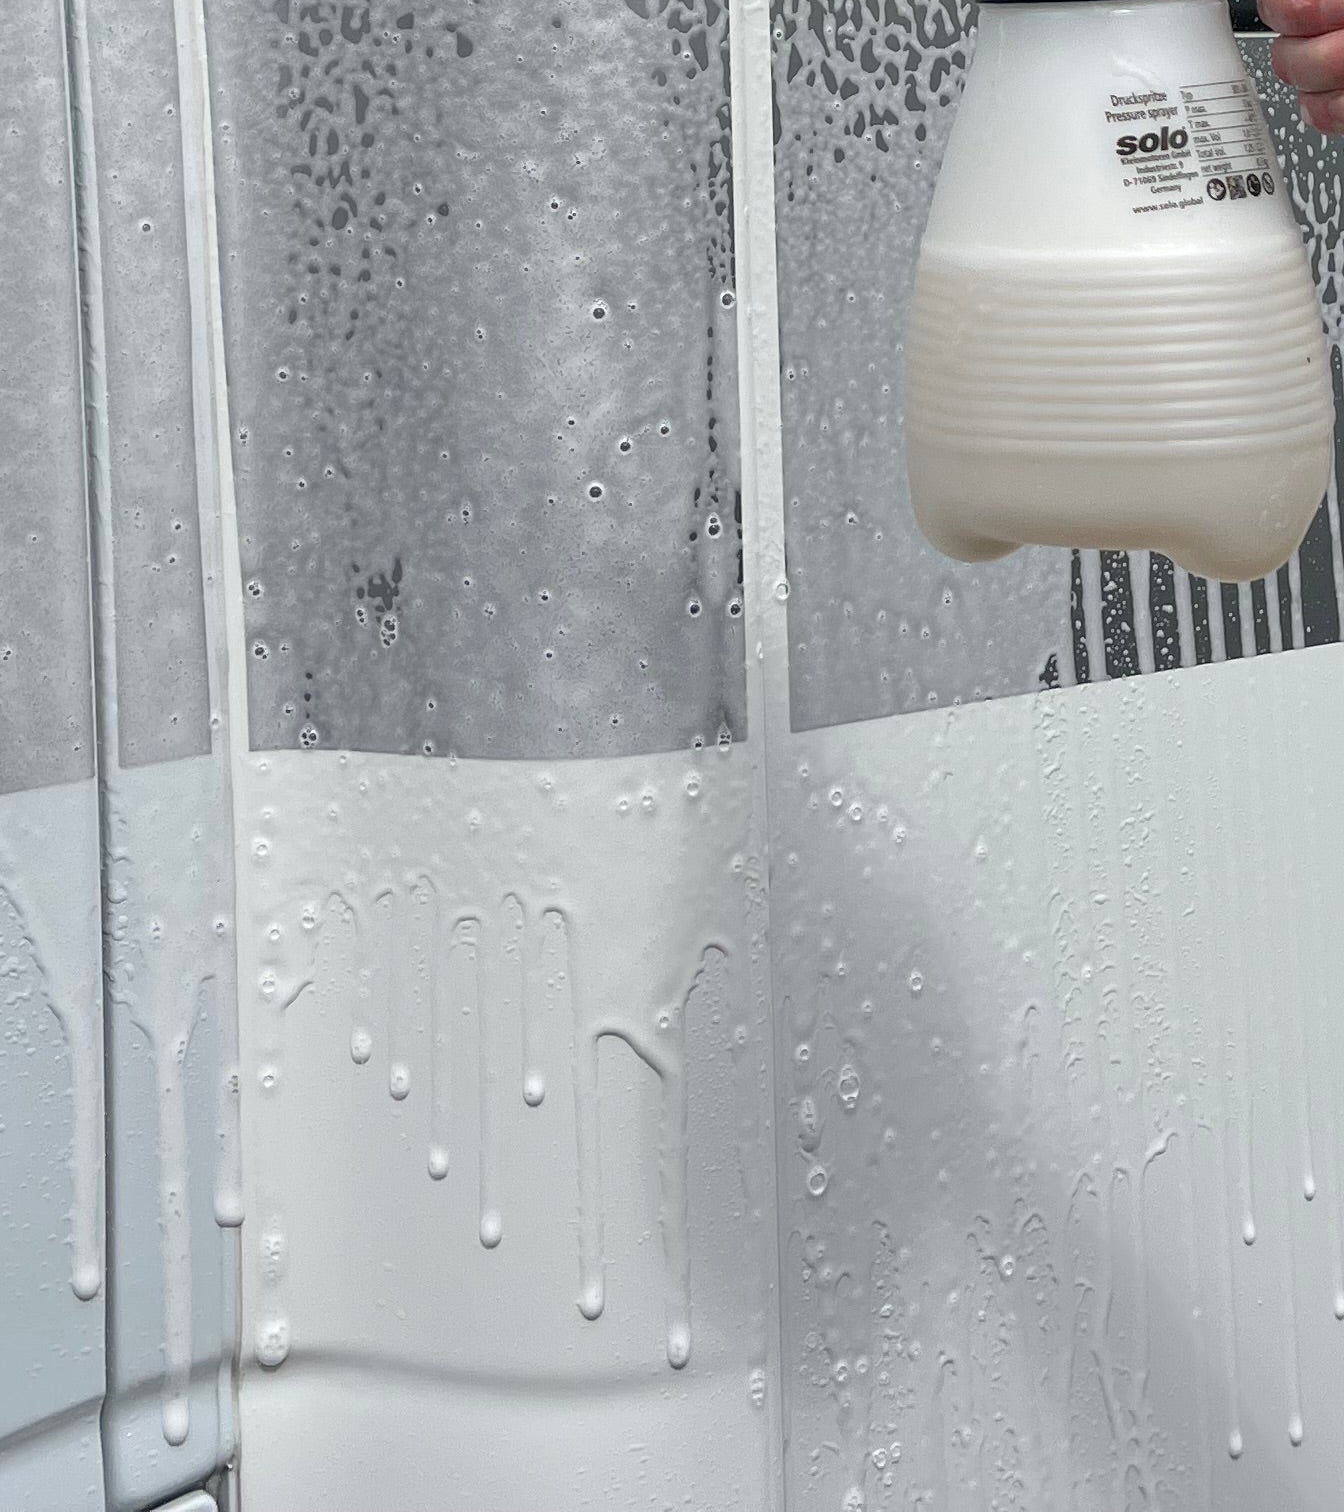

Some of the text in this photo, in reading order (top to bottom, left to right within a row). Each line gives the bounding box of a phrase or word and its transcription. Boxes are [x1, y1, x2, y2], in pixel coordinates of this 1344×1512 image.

[1104, 107, 1178, 123] Pressure sprayer
[1116, 126, 1188, 155] solo
